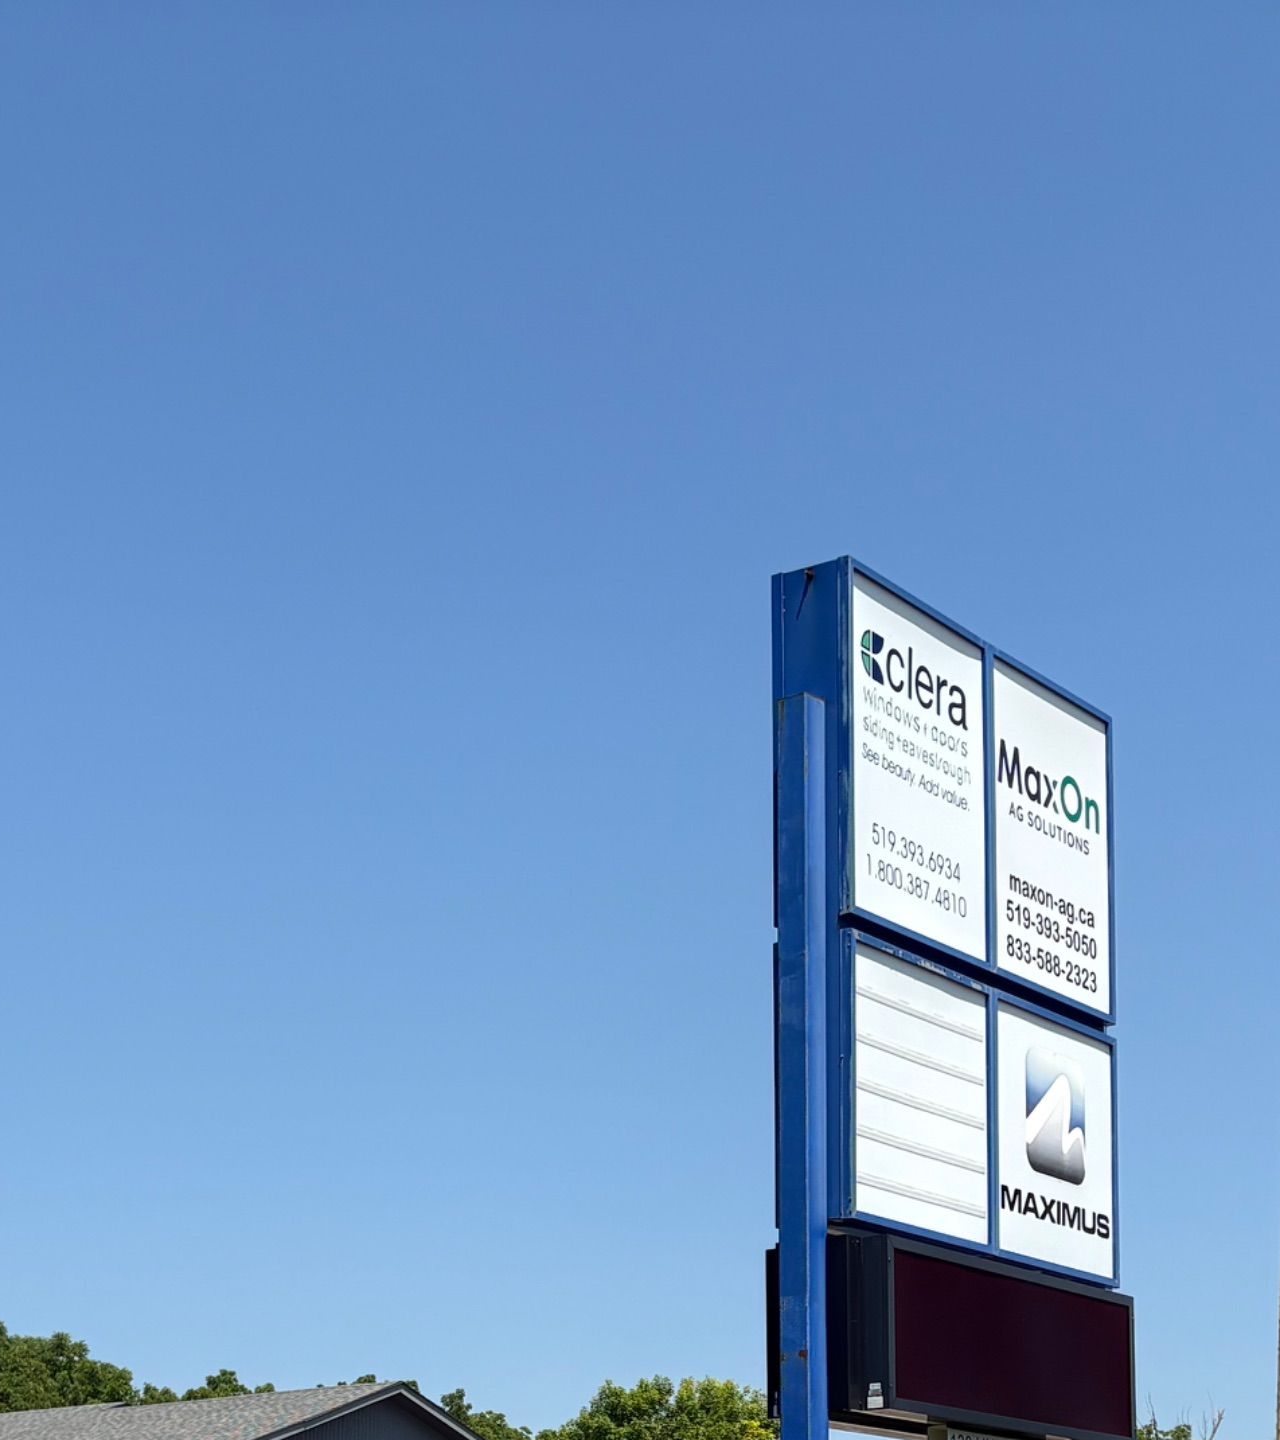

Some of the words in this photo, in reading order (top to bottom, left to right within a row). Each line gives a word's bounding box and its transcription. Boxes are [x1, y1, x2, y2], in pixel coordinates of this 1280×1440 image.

[863, 686, 921, 733] windows
[886, 646, 968, 731] clera
[862, 742, 880, 765] See
[918, 774, 939, 797] Add
[941, 787, 970, 812] value.
[998, 738, 1100, 835] MaxOn
[872, 822, 960, 883] 519.393.6934
[1008, 802, 1024, 822] AG
[1027, 811, 1090, 856] SOLUTIONS
[867, 853, 967, 918] 1.800.387.4810
[1009, 873, 1095, 929] maxon-ag.ca
[1006, 899, 1097, 960] 519-393-5050
[1006, 934, 1097, 993] 833-588-2323
[1001, 1184, 1110, 1240] MAXIMUS
